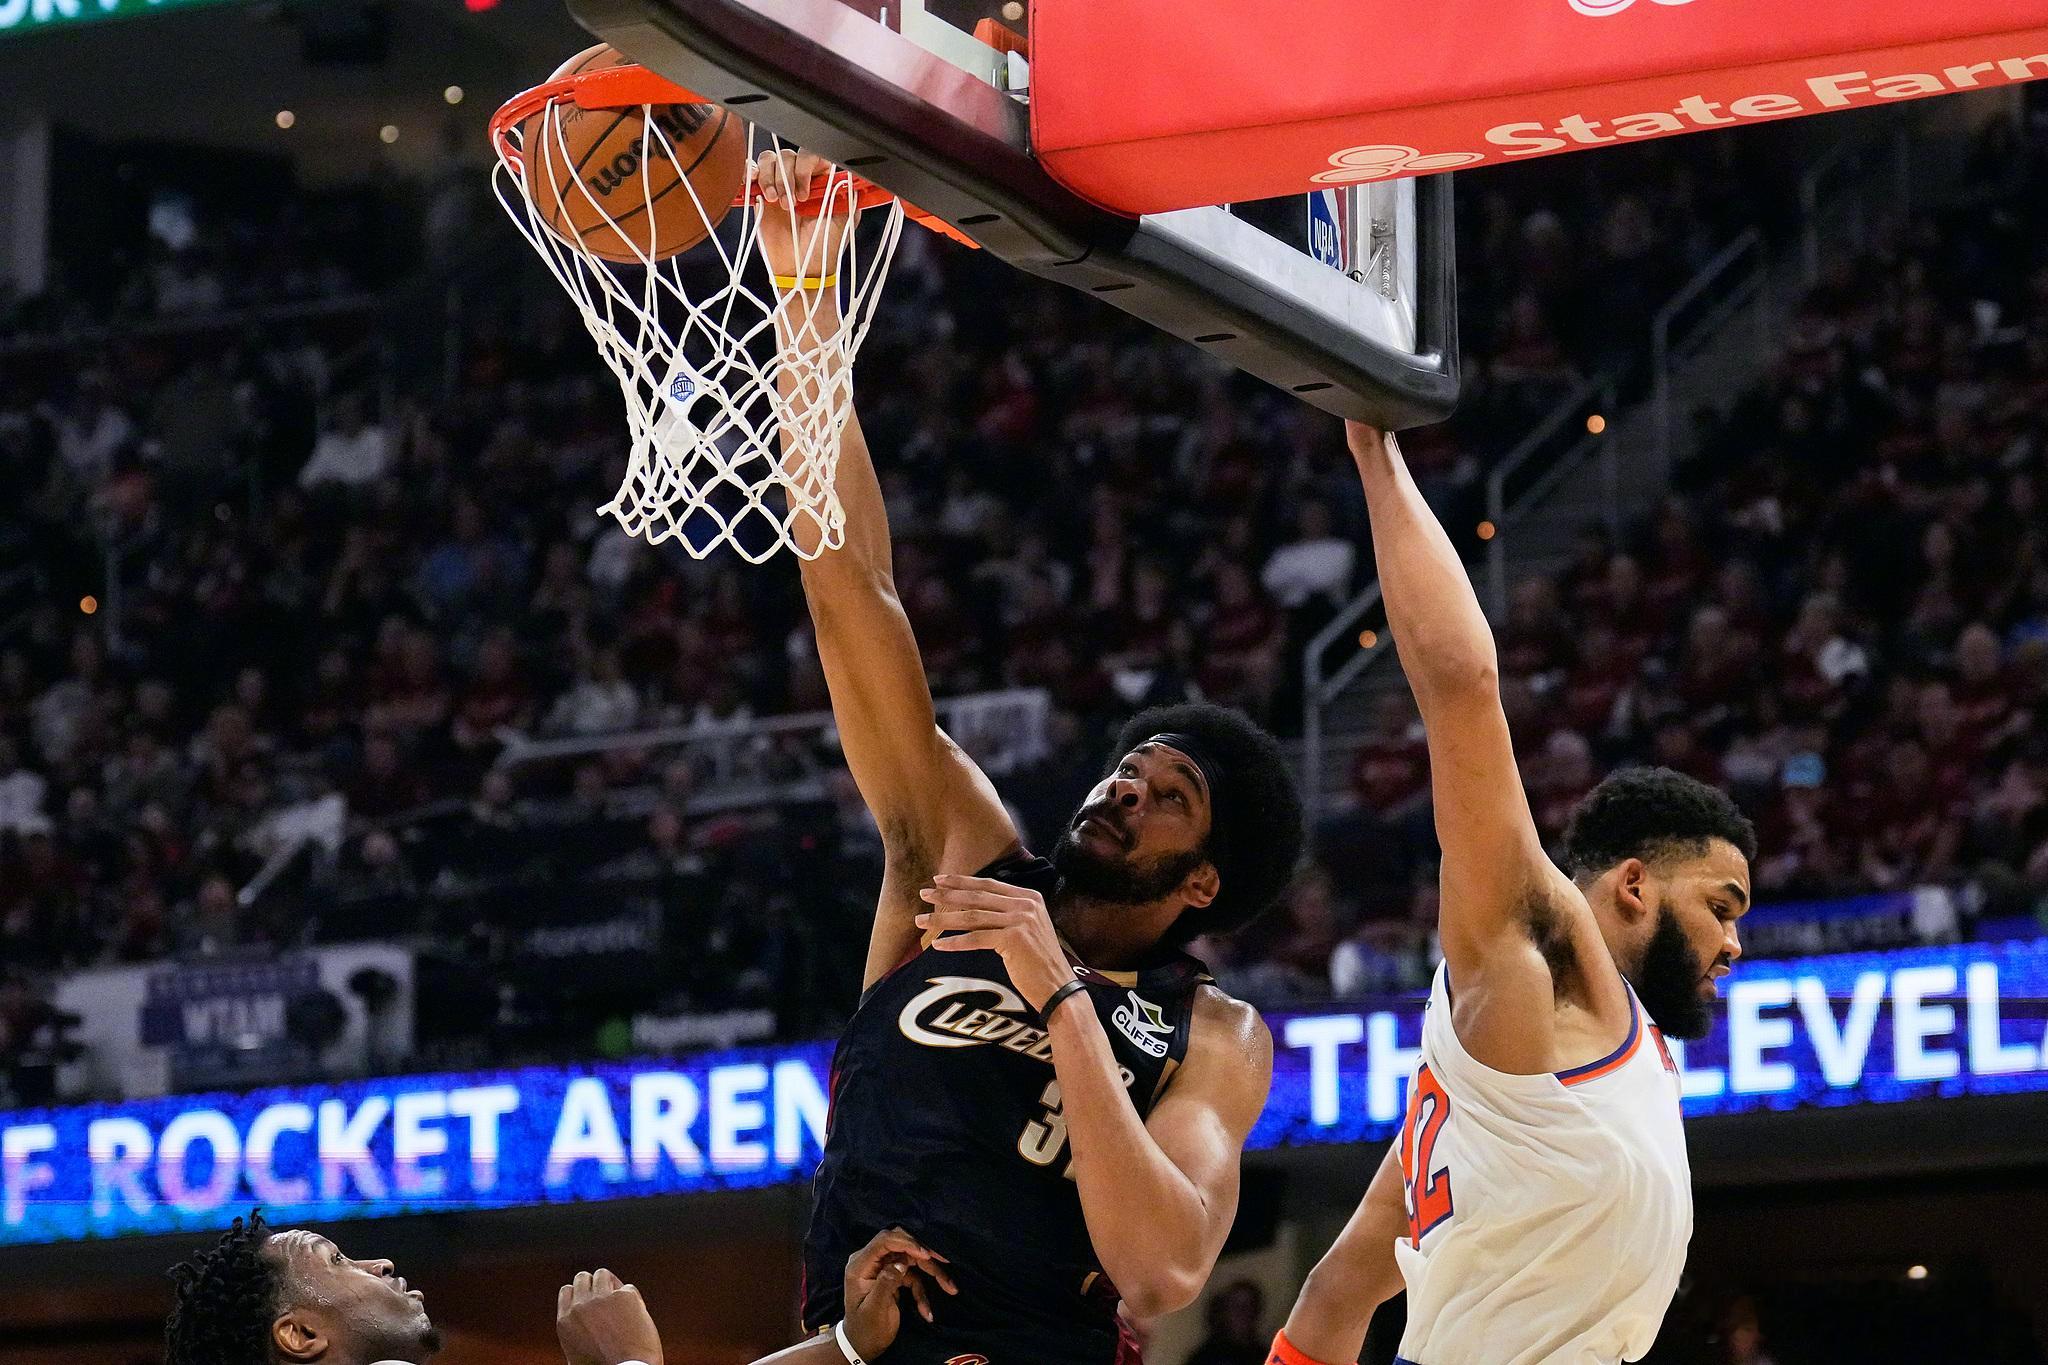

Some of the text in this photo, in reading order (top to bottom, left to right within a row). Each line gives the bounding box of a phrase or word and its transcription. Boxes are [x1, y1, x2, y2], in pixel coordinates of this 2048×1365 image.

[1484, 93, 1804, 156] State
[1313, 217, 1335, 259] NBA
[1114, 1010, 1167, 1056] CLIFFS
[88, 1084, 520, 1218] ROCKET
[543, 1059, 830, 1188] AREN
[1284, 1011, 1424, 1127] TH
[1662, 961, 2048, 1098] LEVEL
[1017, 1079, 1076, 1182] 3
